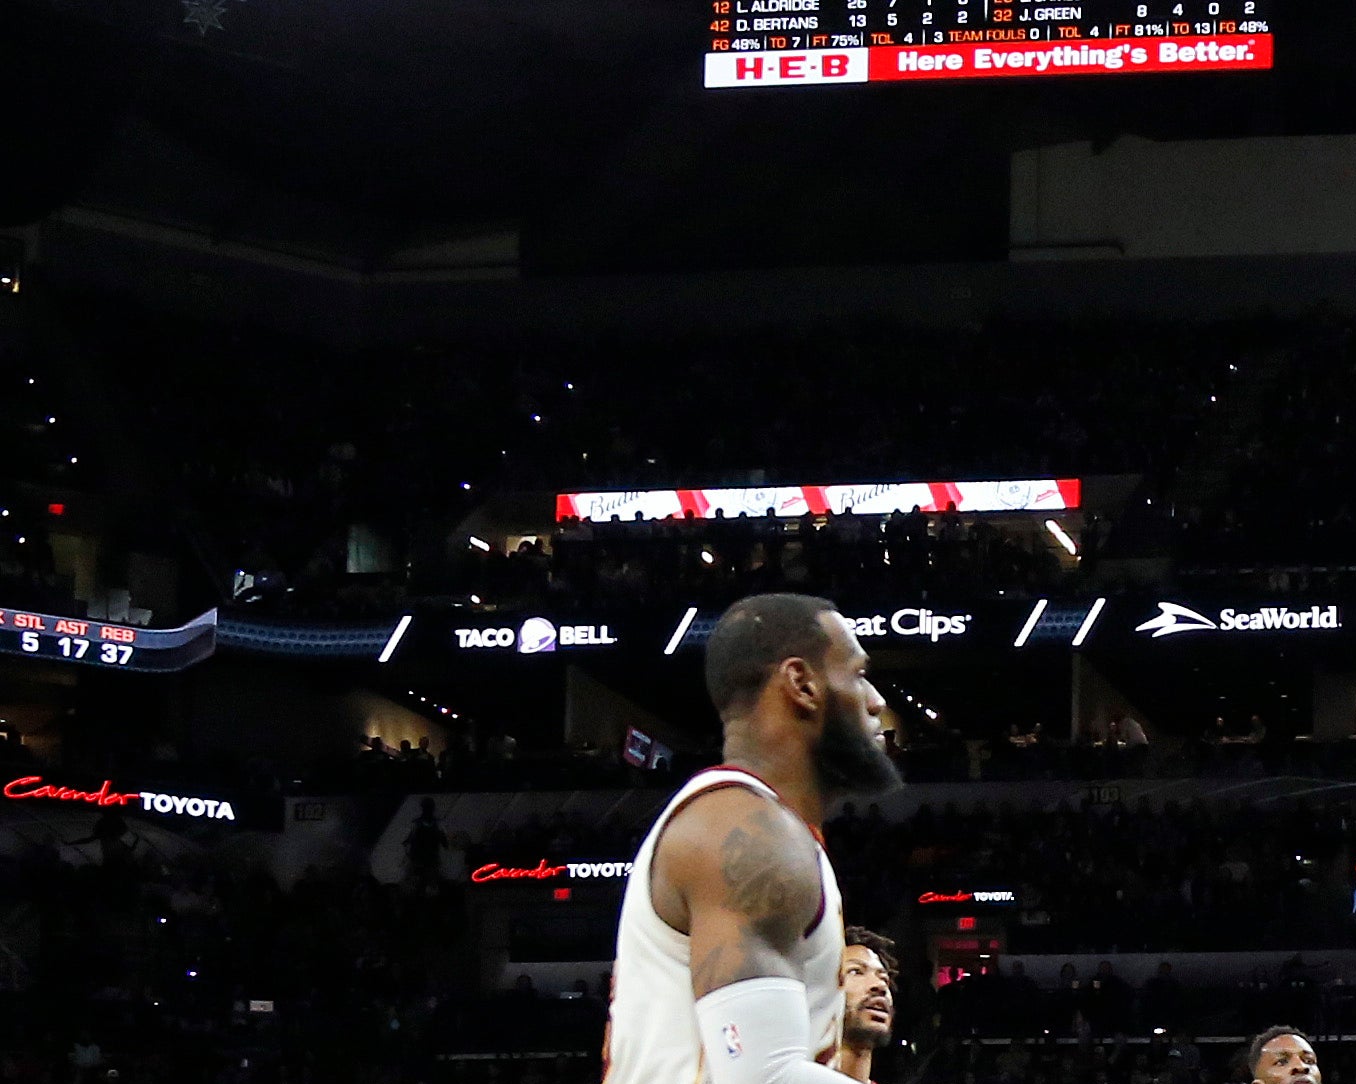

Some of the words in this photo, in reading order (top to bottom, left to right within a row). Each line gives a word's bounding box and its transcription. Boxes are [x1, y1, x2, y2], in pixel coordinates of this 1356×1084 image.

[710, 20, 730, 32] 42
[736, 19, 750, 32] D.
[753, 17, 818, 31] BERTANS
[849, 15, 867, 27] 13
[887, 13, 898, 26] 5
[922, 12, 933, 25] 2
[957, 10, 968, 24] 2
[713, 1, 730, 14] 12
[751, 0, 819, 12] ALDRIDGE
[993, 9, 1012, 22] 32
[1019, 8, 1032, 21] J.
[1034, 7, 1082, 20] GREEN
[1137, 4, 1147, 18] 8
[1172, 3, 1183, 16] 4
[1208, 2, 1219, 15] 0
[1244, 1, 1255, 14] 2
[712, 40, 730, 51] FG
[731, 38, 760, 50] 48%
[770, 37, 786, 48] TO
[792, 36, 801, 48] 7
[812, 35, 828, 47] FT
[831, 34, 860, 46] 75%
[871, 33, 894, 44] TOL
[904, 32, 913, 44] 4
[933, 31, 943, 43] 3
[948, 30, 983, 42] TEAM
[986, 28, 1026, 40] FOULS
[1029, 28, 1040, 40] 0
[1058, 26, 1081, 38] TOL
[1089, 25, 1099, 37] 4
[1115, 25, 1131, 36] FT
[1172, 23, 1190, 34] TO
[1194, 22, 1211, 34] 13
[1219, 21, 1236, 33] FG
[1238, 21, 1269, 33] 48%
[898, 51, 964, 72] Here
[974, 44, 1148, 71] Everything's
[1159, 40, 1254, 63] Better.
[14, 614, 46, 630] STL
[55, 619, 89, 636] AST
[100, 626, 136, 643] REB
[844, 615, 886, 636] eat
[891, 608, 966, 642] Clips
[1220, 606, 1338, 630] SeaWorld
[22, 631, 39, 652] 5
[58, 637, 89, 658] 17
[100, 643, 134, 664] 37
[455, 628, 515, 648] TACO
[560, 625, 614, 645] BELL
[4, 775, 140, 805] Cavender
[140, 791, 235, 820] TOYOTA
